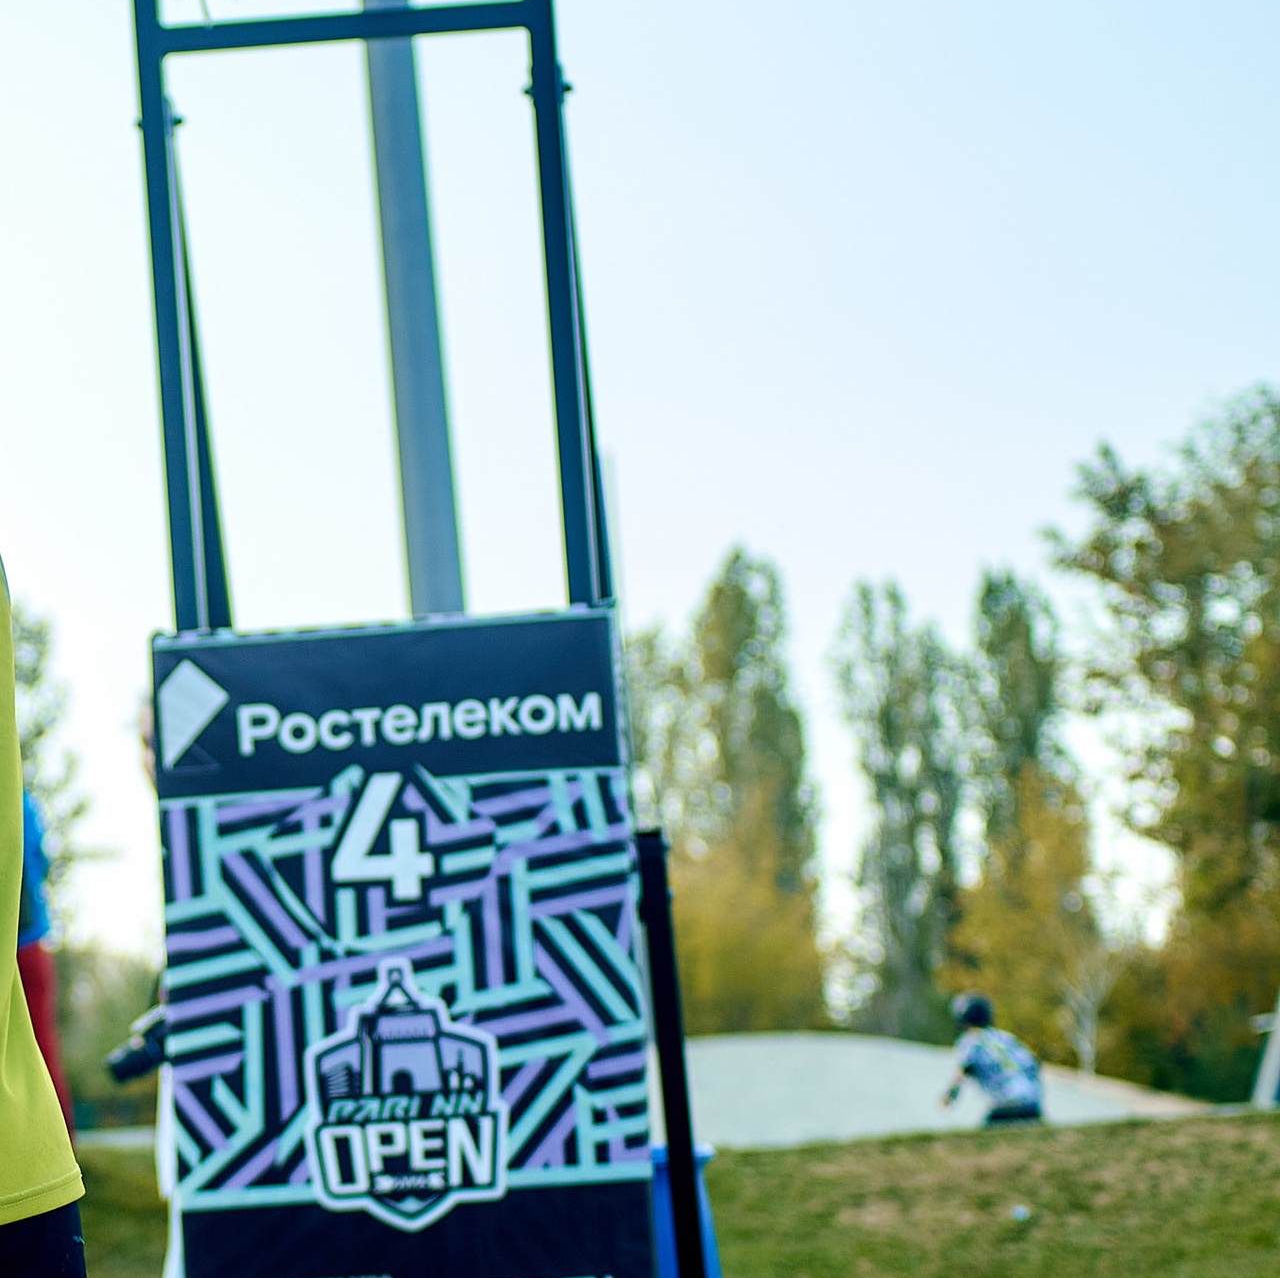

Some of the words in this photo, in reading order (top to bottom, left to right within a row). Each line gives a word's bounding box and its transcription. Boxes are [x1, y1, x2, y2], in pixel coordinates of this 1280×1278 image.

[236, 692, 602, 756] Ростелеком
[331, 771, 434, 900] 4
[327, 1094, 420, 1124] PARI
[431, 1090, 483, 1116] NN
[320, 1114, 493, 1195] OPEN
